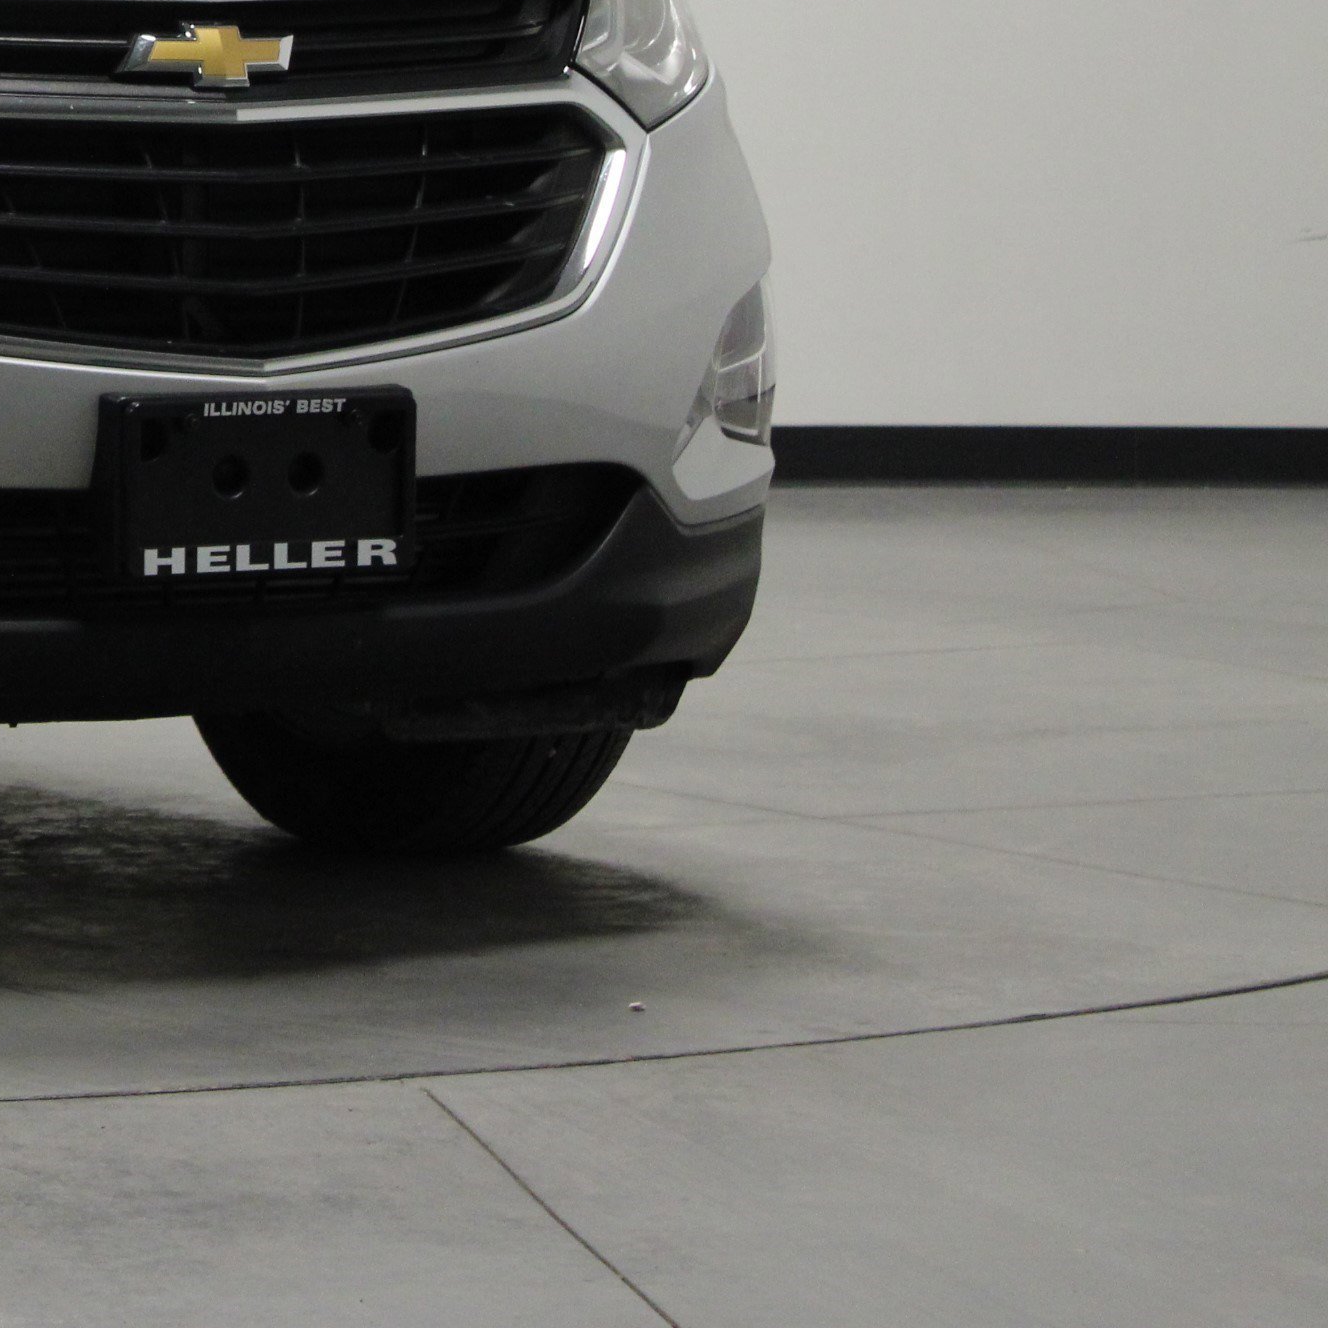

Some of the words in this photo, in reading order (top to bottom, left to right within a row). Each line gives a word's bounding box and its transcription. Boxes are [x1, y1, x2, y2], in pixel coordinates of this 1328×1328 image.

[203, 399, 290, 417] ILLINOIS'
[296, 398, 346, 415] BEST
[144, 538, 397, 576] HELLER
